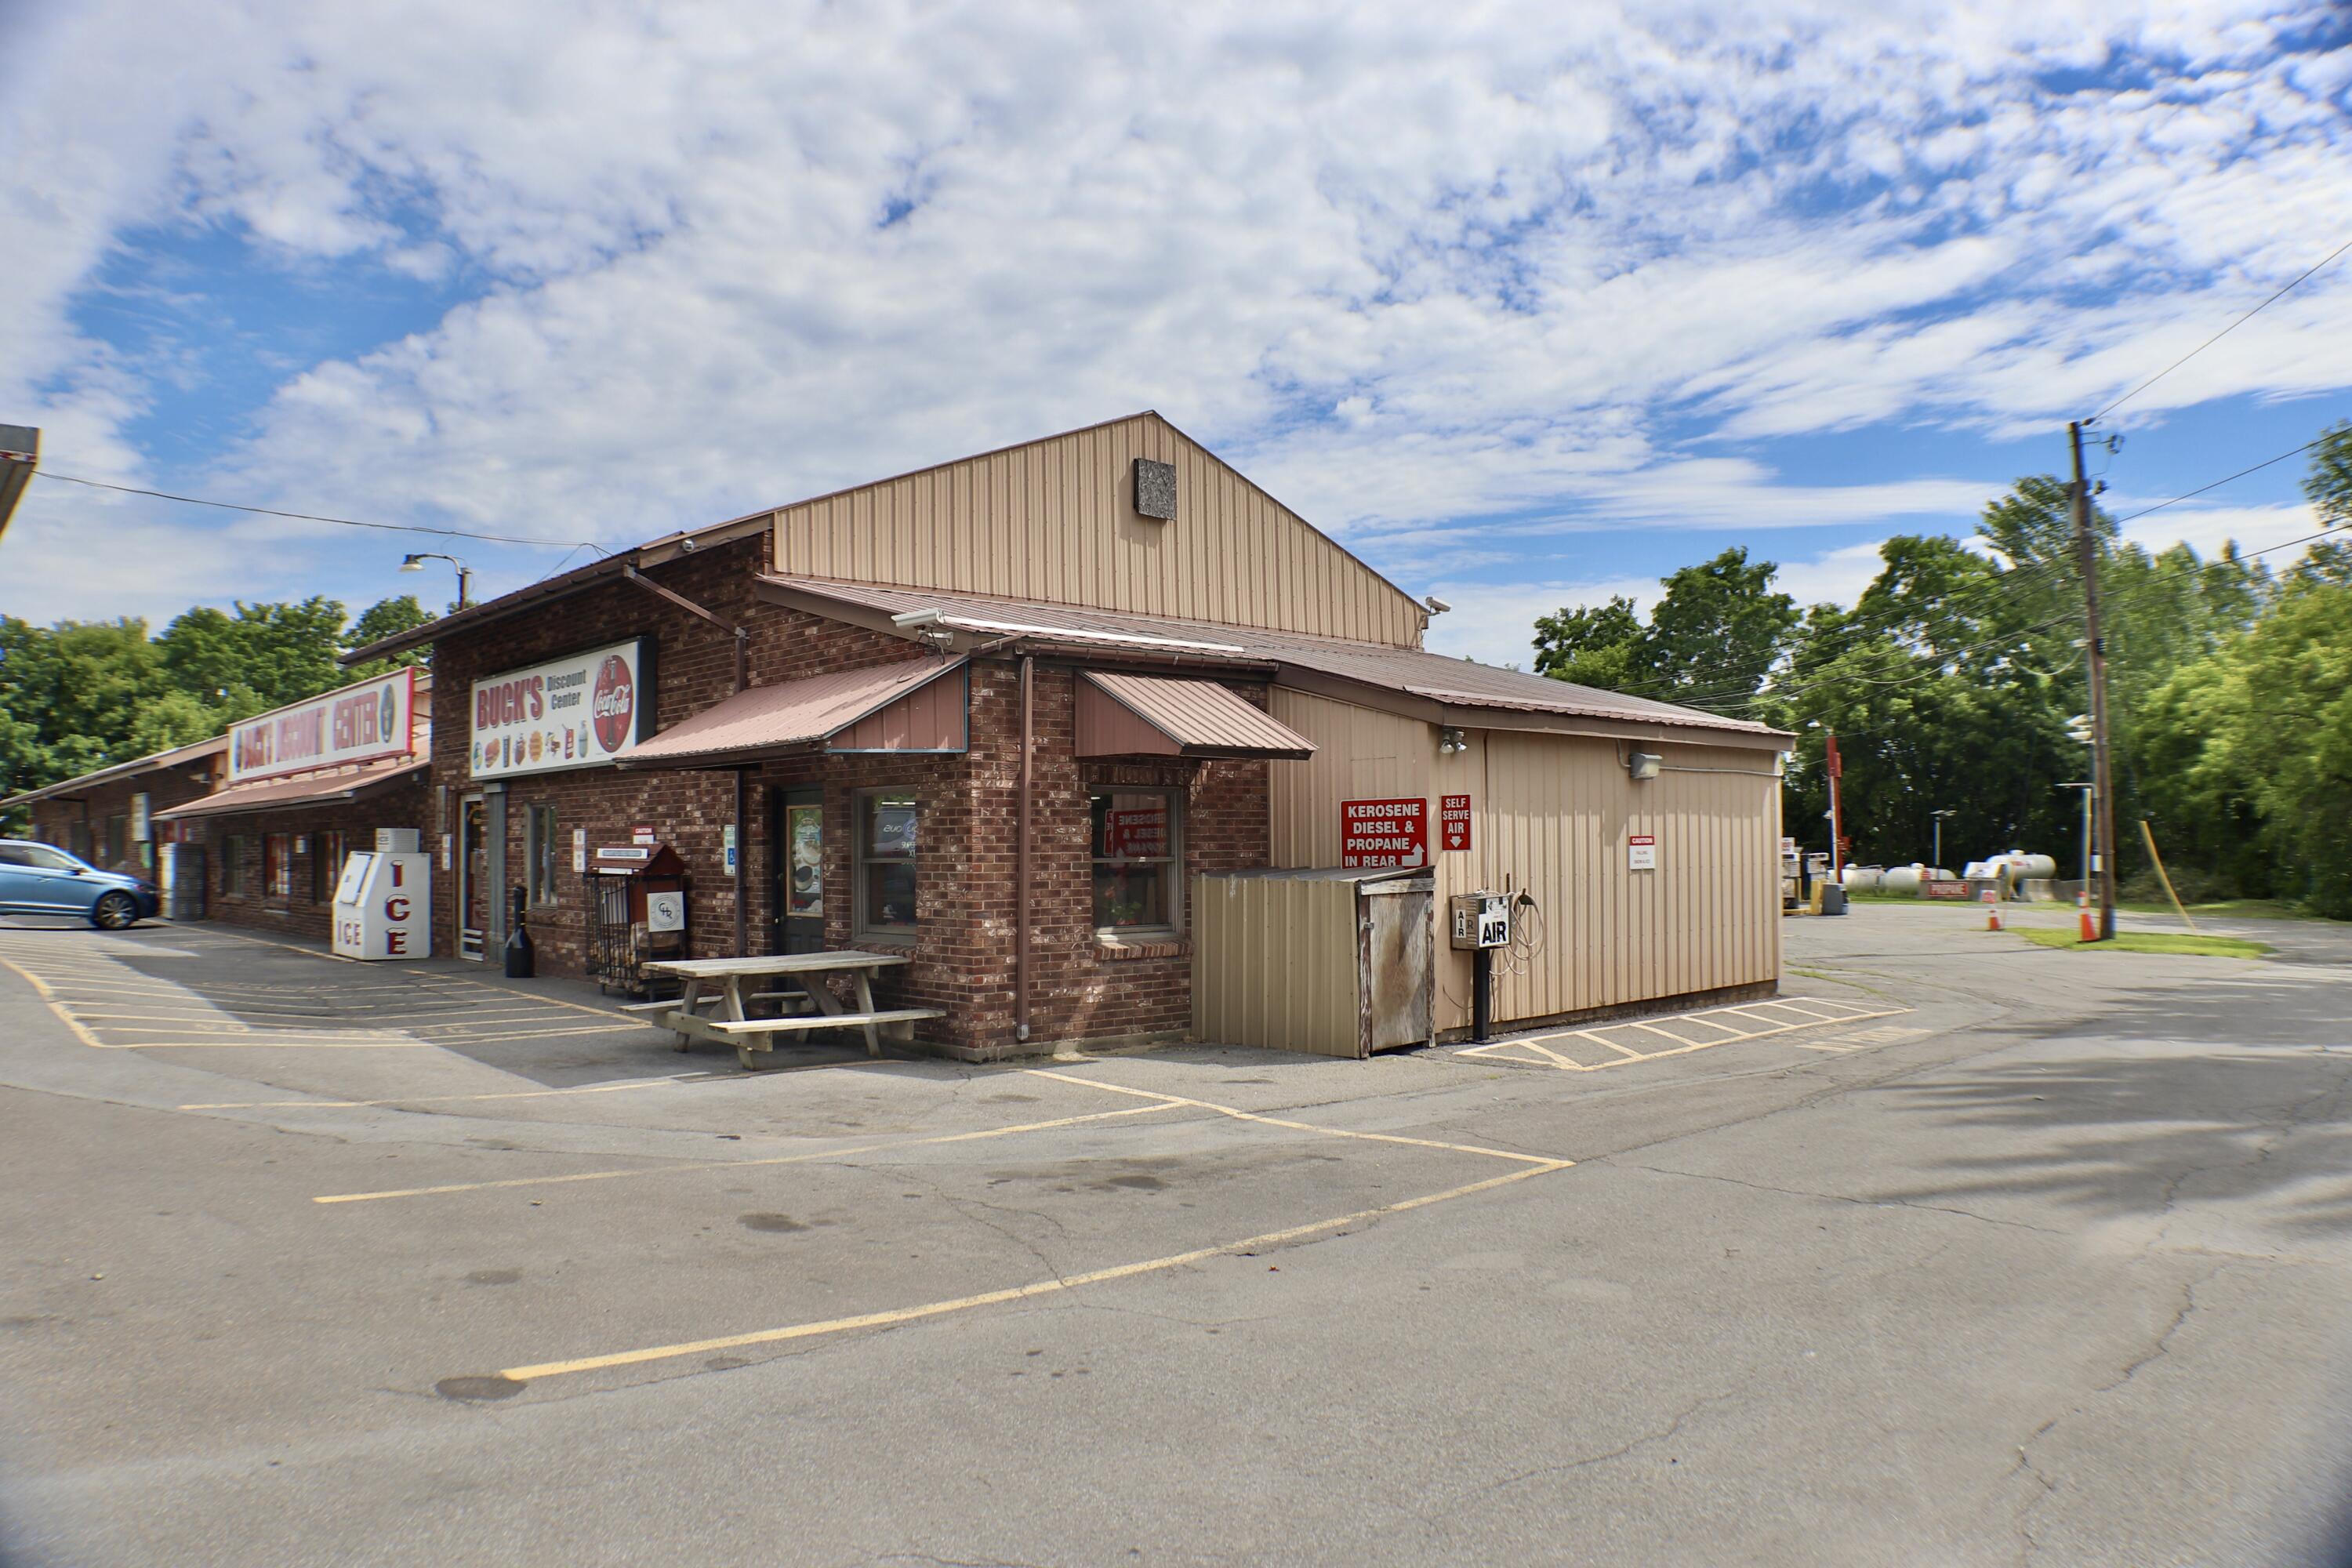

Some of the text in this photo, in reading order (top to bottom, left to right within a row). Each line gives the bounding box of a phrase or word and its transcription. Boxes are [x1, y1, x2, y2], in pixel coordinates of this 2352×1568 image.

[547, 670, 586, 691] Discount
[477, 675, 544, 730] BUCK'S
[551, 691, 581, 710] Center
[1445, 798, 1466, 808] SELF
[1348, 804, 1420, 818] KEROSENE
[1443, 810, 1469, 820] SERVE
[1353, 821, 1414, 834] DIESEL &
[1447, 822, 1464, 834] AIR
[1347, 837, 1410, 851] PROPANE
[1345, 855, 1396, 866] IN REAR
[385, 859, 410, 955] ICE
[337, 918, 361, 946] ICE
[1482, 920, 1507, 944] AIR
